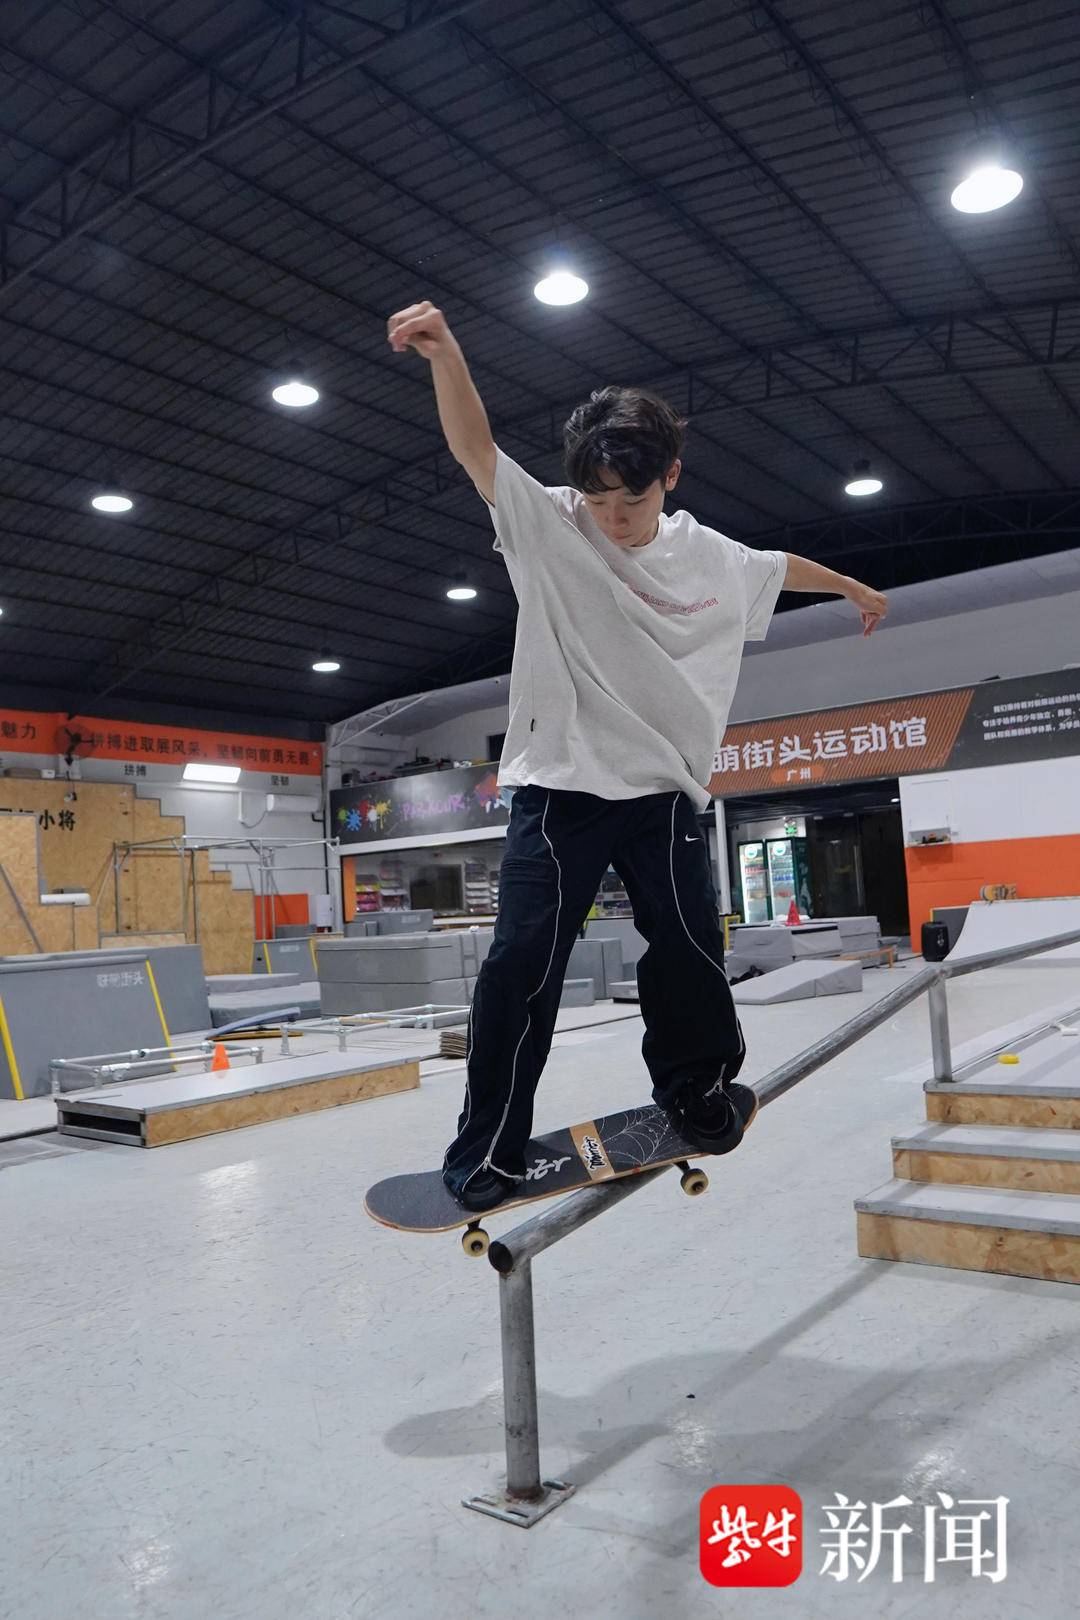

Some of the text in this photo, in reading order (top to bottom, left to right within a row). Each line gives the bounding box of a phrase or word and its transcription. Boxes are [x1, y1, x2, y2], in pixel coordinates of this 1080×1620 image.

[1, 720, 36, 739] 魅力
[712, 717, 927, 773] 萌街头运动馆
[787, 767, 811, 781] 广州
